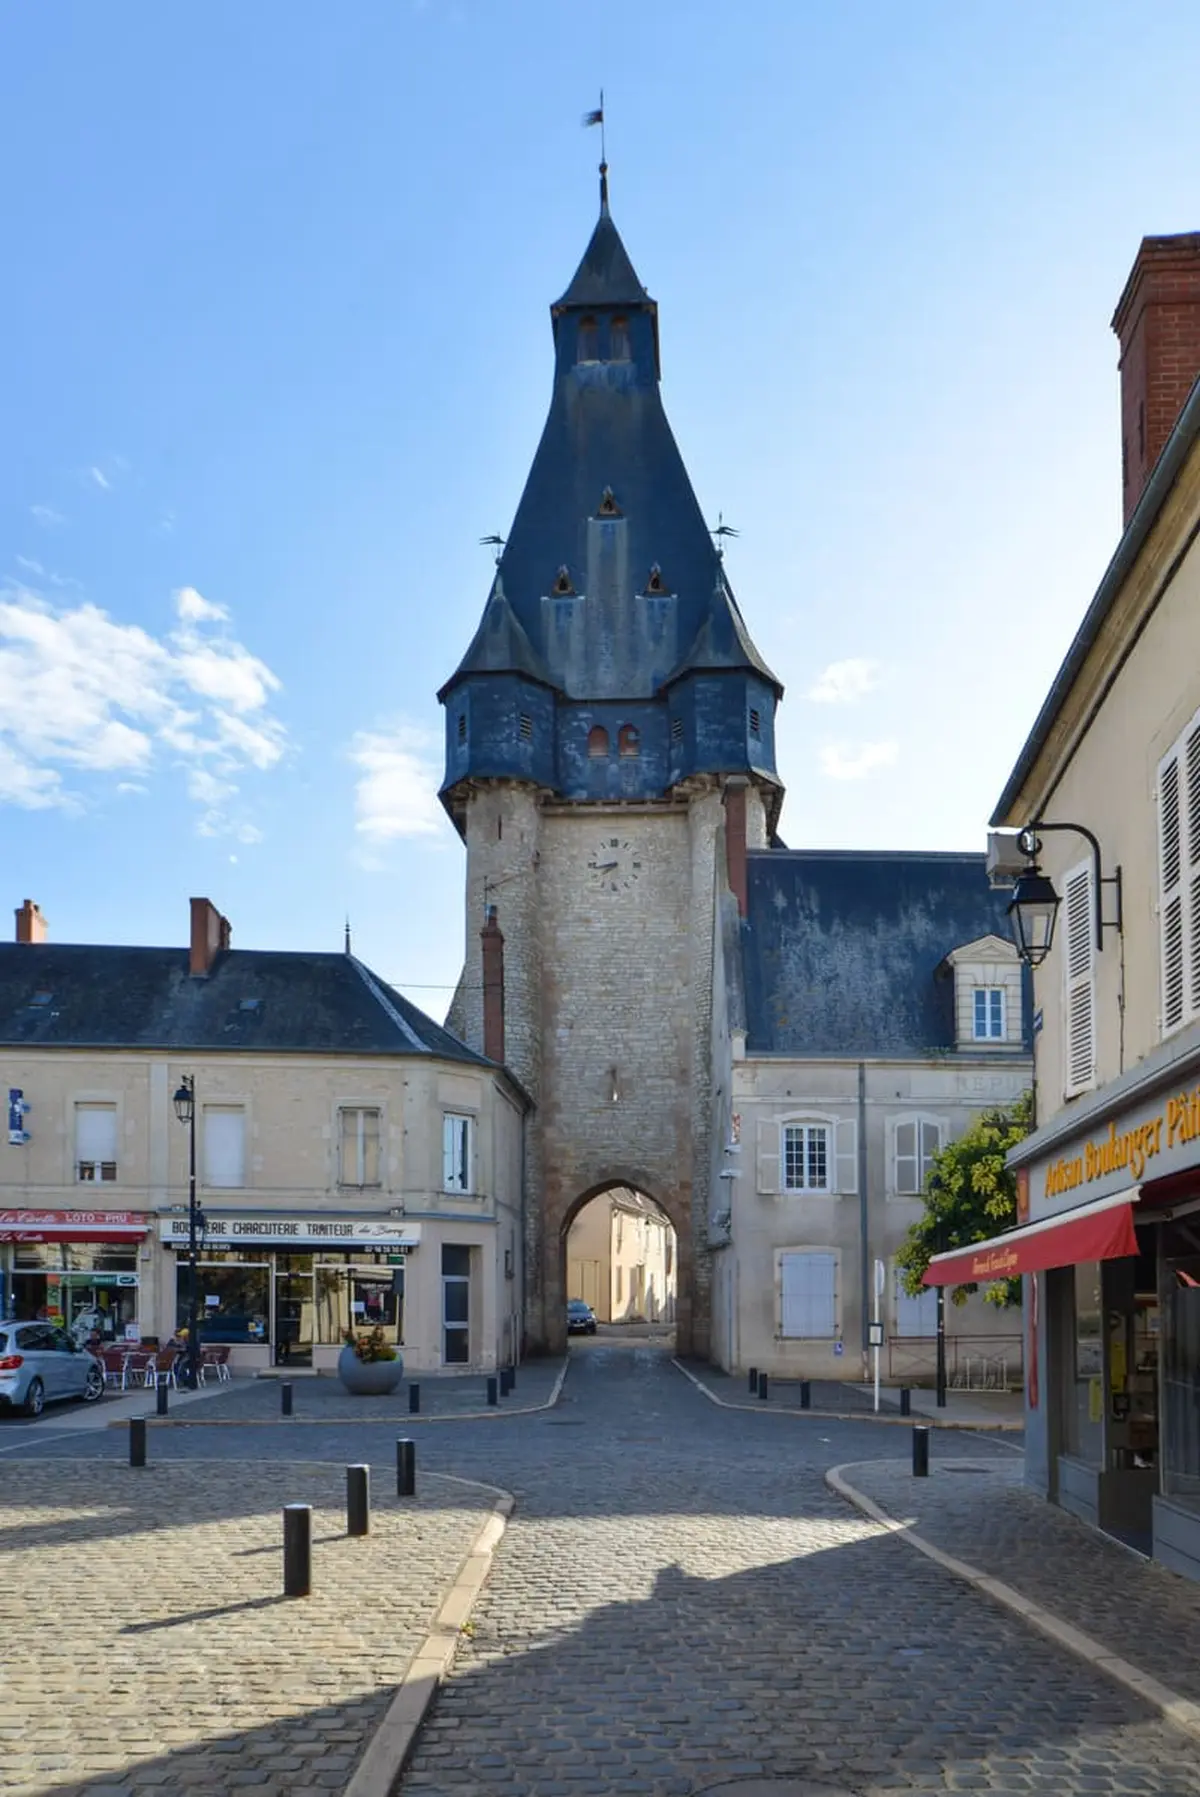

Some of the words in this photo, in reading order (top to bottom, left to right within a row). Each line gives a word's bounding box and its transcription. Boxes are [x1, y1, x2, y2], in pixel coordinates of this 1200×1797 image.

[1044, 1156, 1083, 1199] Artisan
[1084, 1118, 1163, 1181] Boulanger
[65, 1212, 95, 1223] LOTO
[105, 1212, 128, 1223] PMU
[172, 1221, 227, 1234] BOUERIE
[233, 1222, 299, 1235] CHARCUTERIE
[307, 1223, 353, 1236] TRAITEUR
